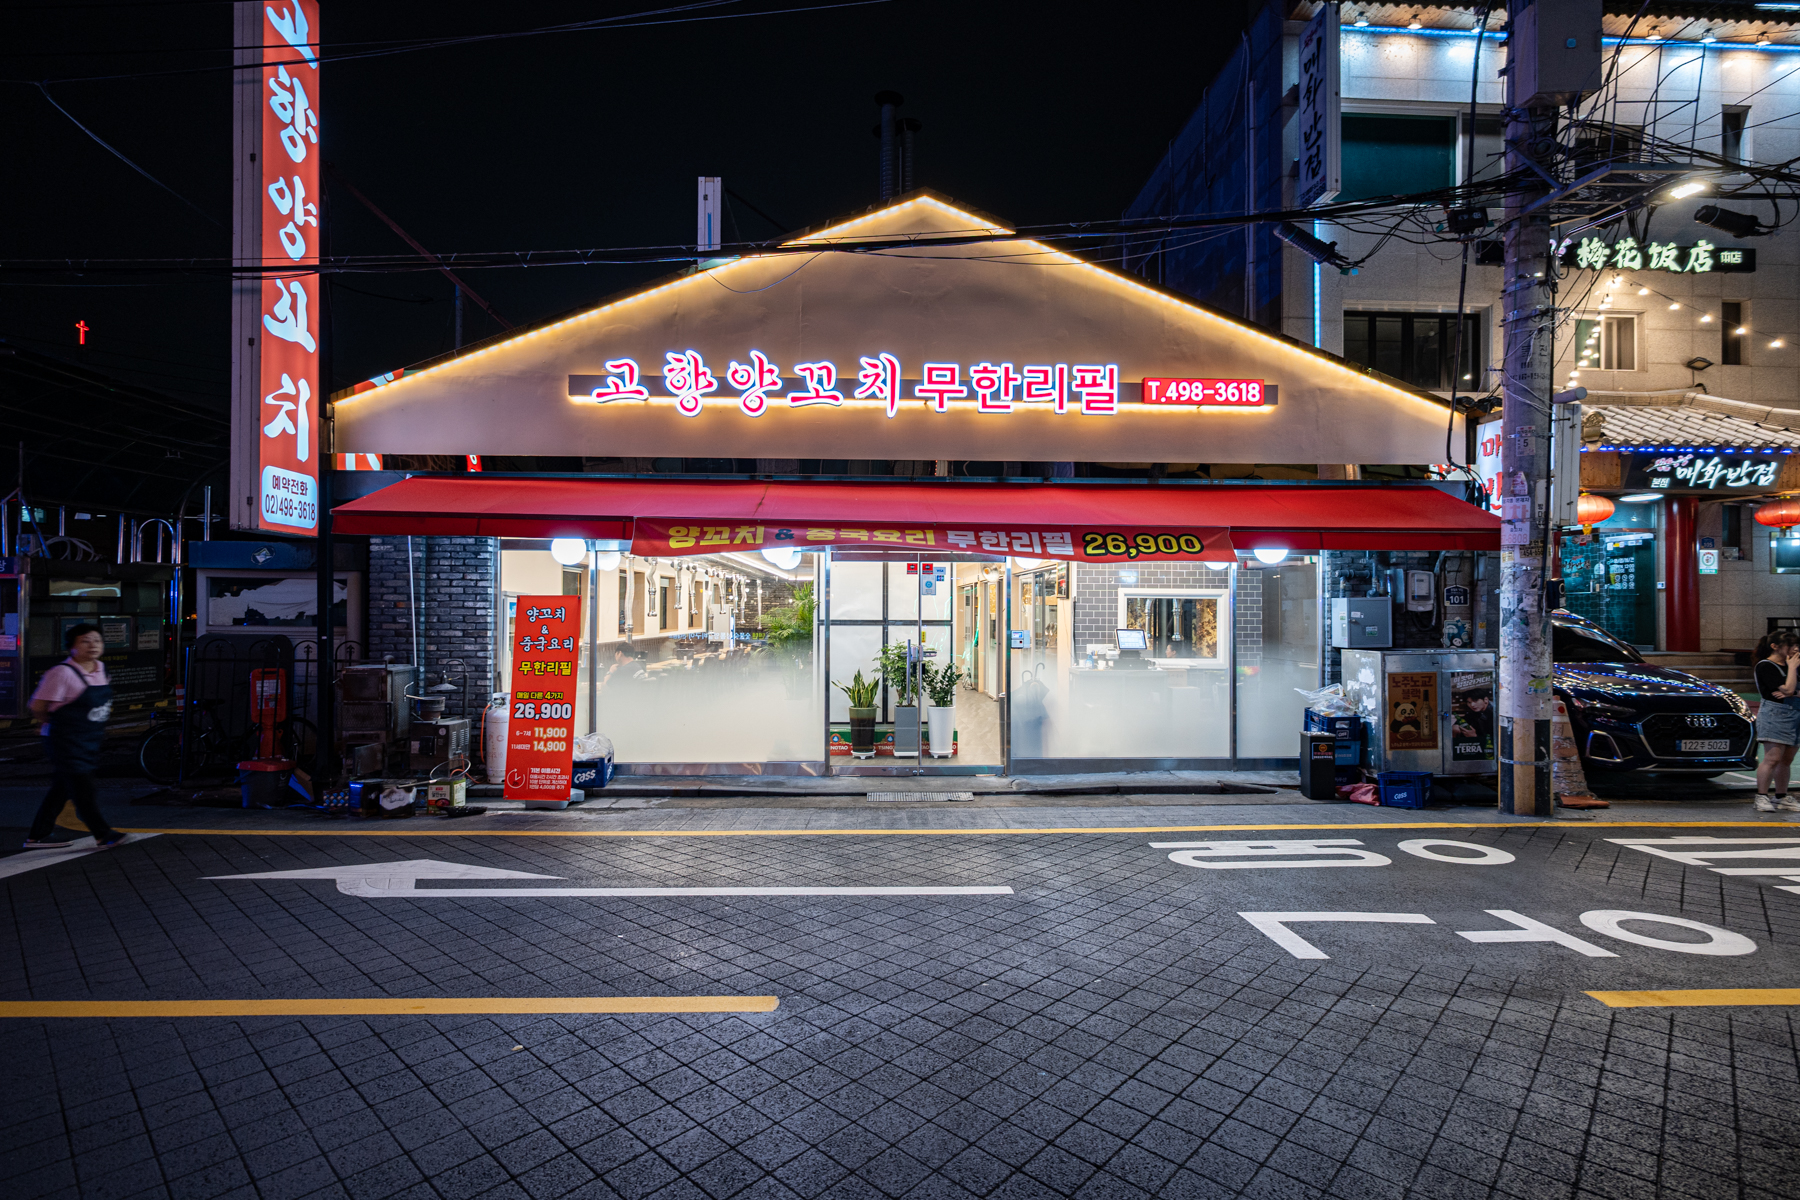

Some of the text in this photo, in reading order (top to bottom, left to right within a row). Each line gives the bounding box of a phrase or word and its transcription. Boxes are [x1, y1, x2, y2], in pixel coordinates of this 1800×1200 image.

[1302, 37, 1323, 181] 매화반점
[1576, 236, 1715, 273] 梅花饭店
[591, 350, 1262, 418] 고향양꼬치 무한리필 T.498-3618
[1675, 457, 1778, 490] 매화반점
[271, 474, 308, 496] 예약전화
[264, 494, 316, 521] 02)498-3618
[668, 526, 1204, 560] 양꼬치 & 중국요리 무한리필 26,900
[1449, 595, 1464, 604] 101
[526, 606, 566, 623] 양꼬치
[541, 625, 549, 635] &
[519, 636, 574, 652] 중국요리
[518, 661, 572, 676] 무한리필
[1392, 675, 1433, 688] 노주노교
[1402, 688, 1421, 699] 블랙
[514, 702, 572, 720] 26,900
[533, 727, 567, 739] 11,900
[533, 740, 566, 753] 14,900
[1455, 746, 1482, 754] TERRA
[1683, 740, 1729, 751] 122주 5023
